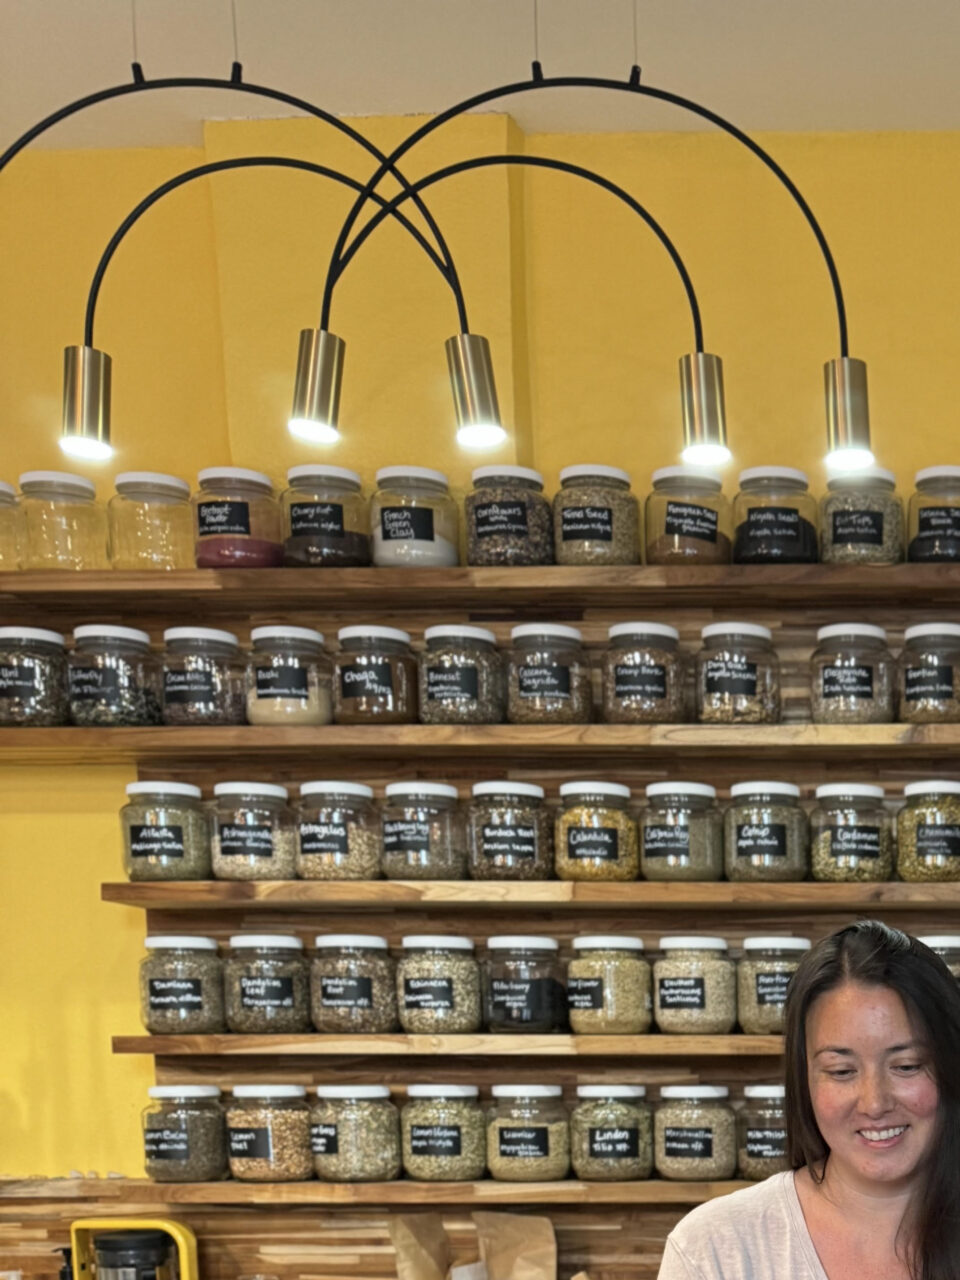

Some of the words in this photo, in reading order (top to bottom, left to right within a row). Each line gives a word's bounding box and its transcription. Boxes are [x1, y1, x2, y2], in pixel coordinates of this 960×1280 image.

[384, 511, 411, 520] French
[390, 528, 415, 538] Clay
[345, 671, 378, 684] Chaga
[595, 1130, 629, 1141] Linden
